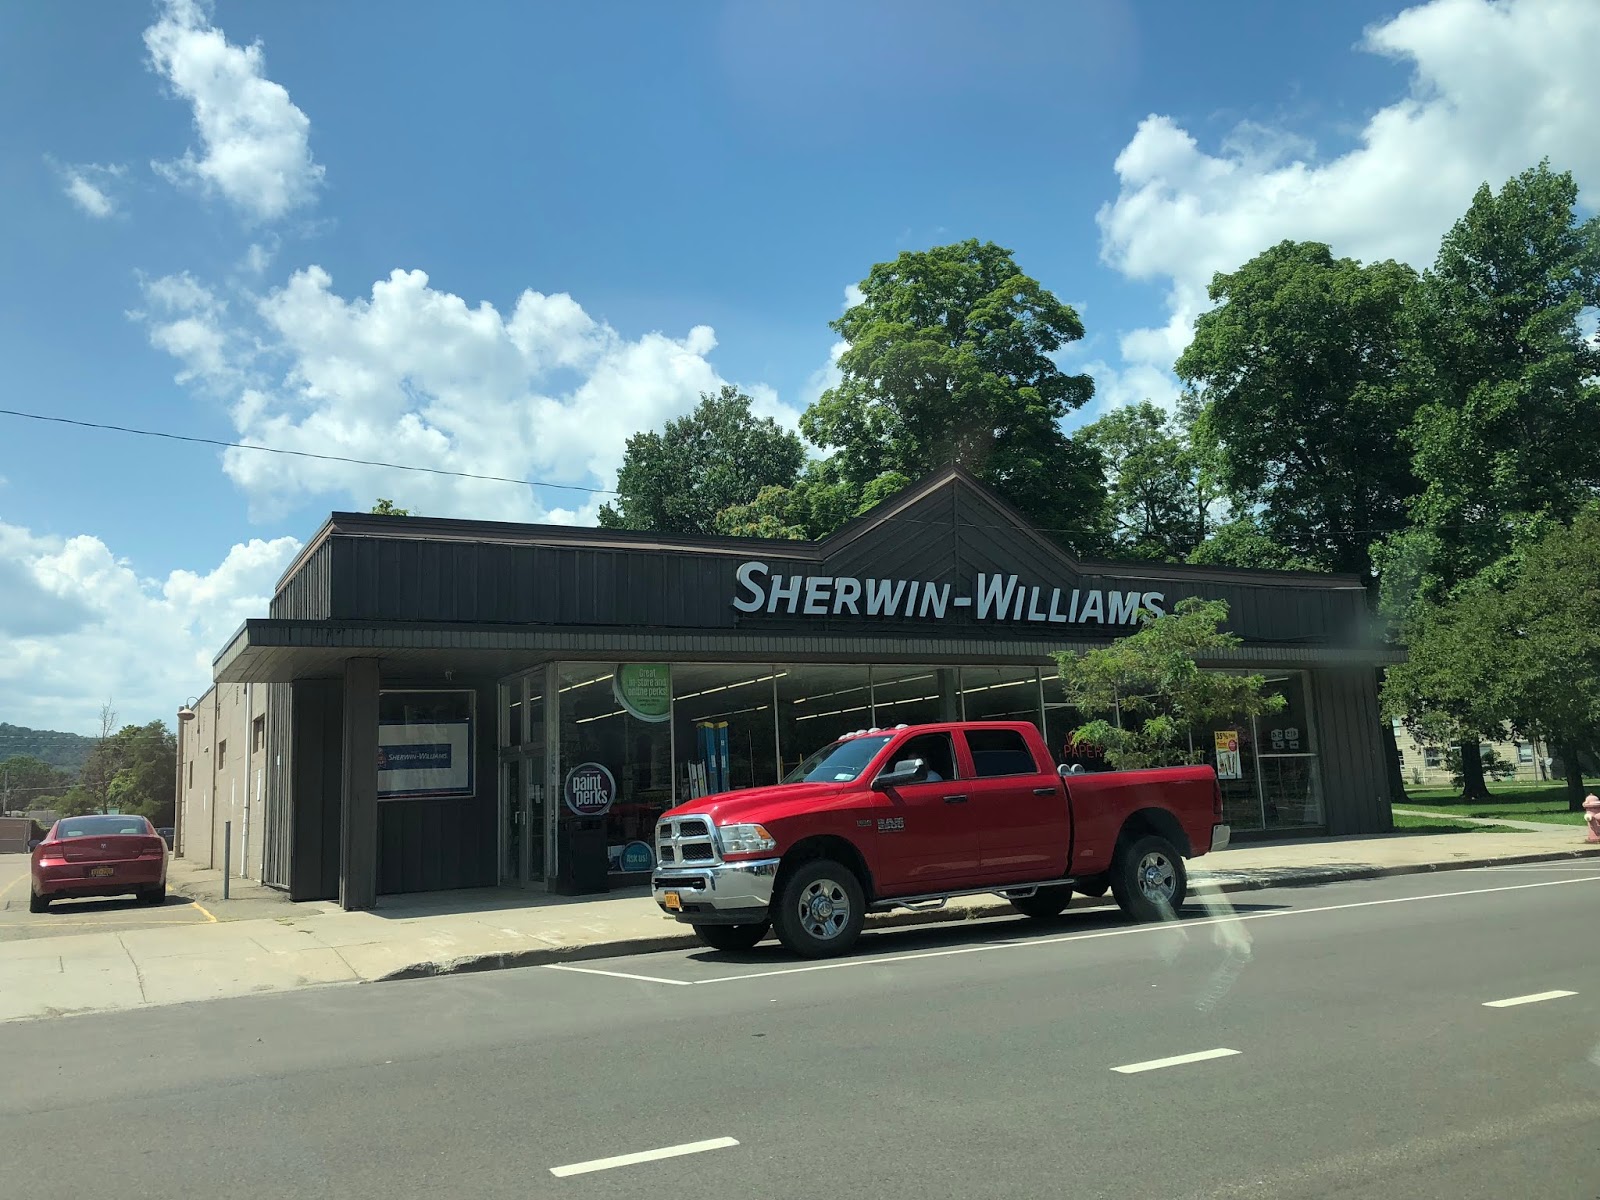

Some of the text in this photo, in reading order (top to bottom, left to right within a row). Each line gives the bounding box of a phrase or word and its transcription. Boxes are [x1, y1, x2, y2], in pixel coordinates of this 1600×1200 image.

[733, 561, 1165, 625] SHERWIN-WILLIAMS
[639, 669, 656, 678] Great
[654, 678, 667, 687] and
[1063, 744, 1104, 759] PAPER
[572, 773, 602, 794] paint
[575, 788, 608, 808] perks
